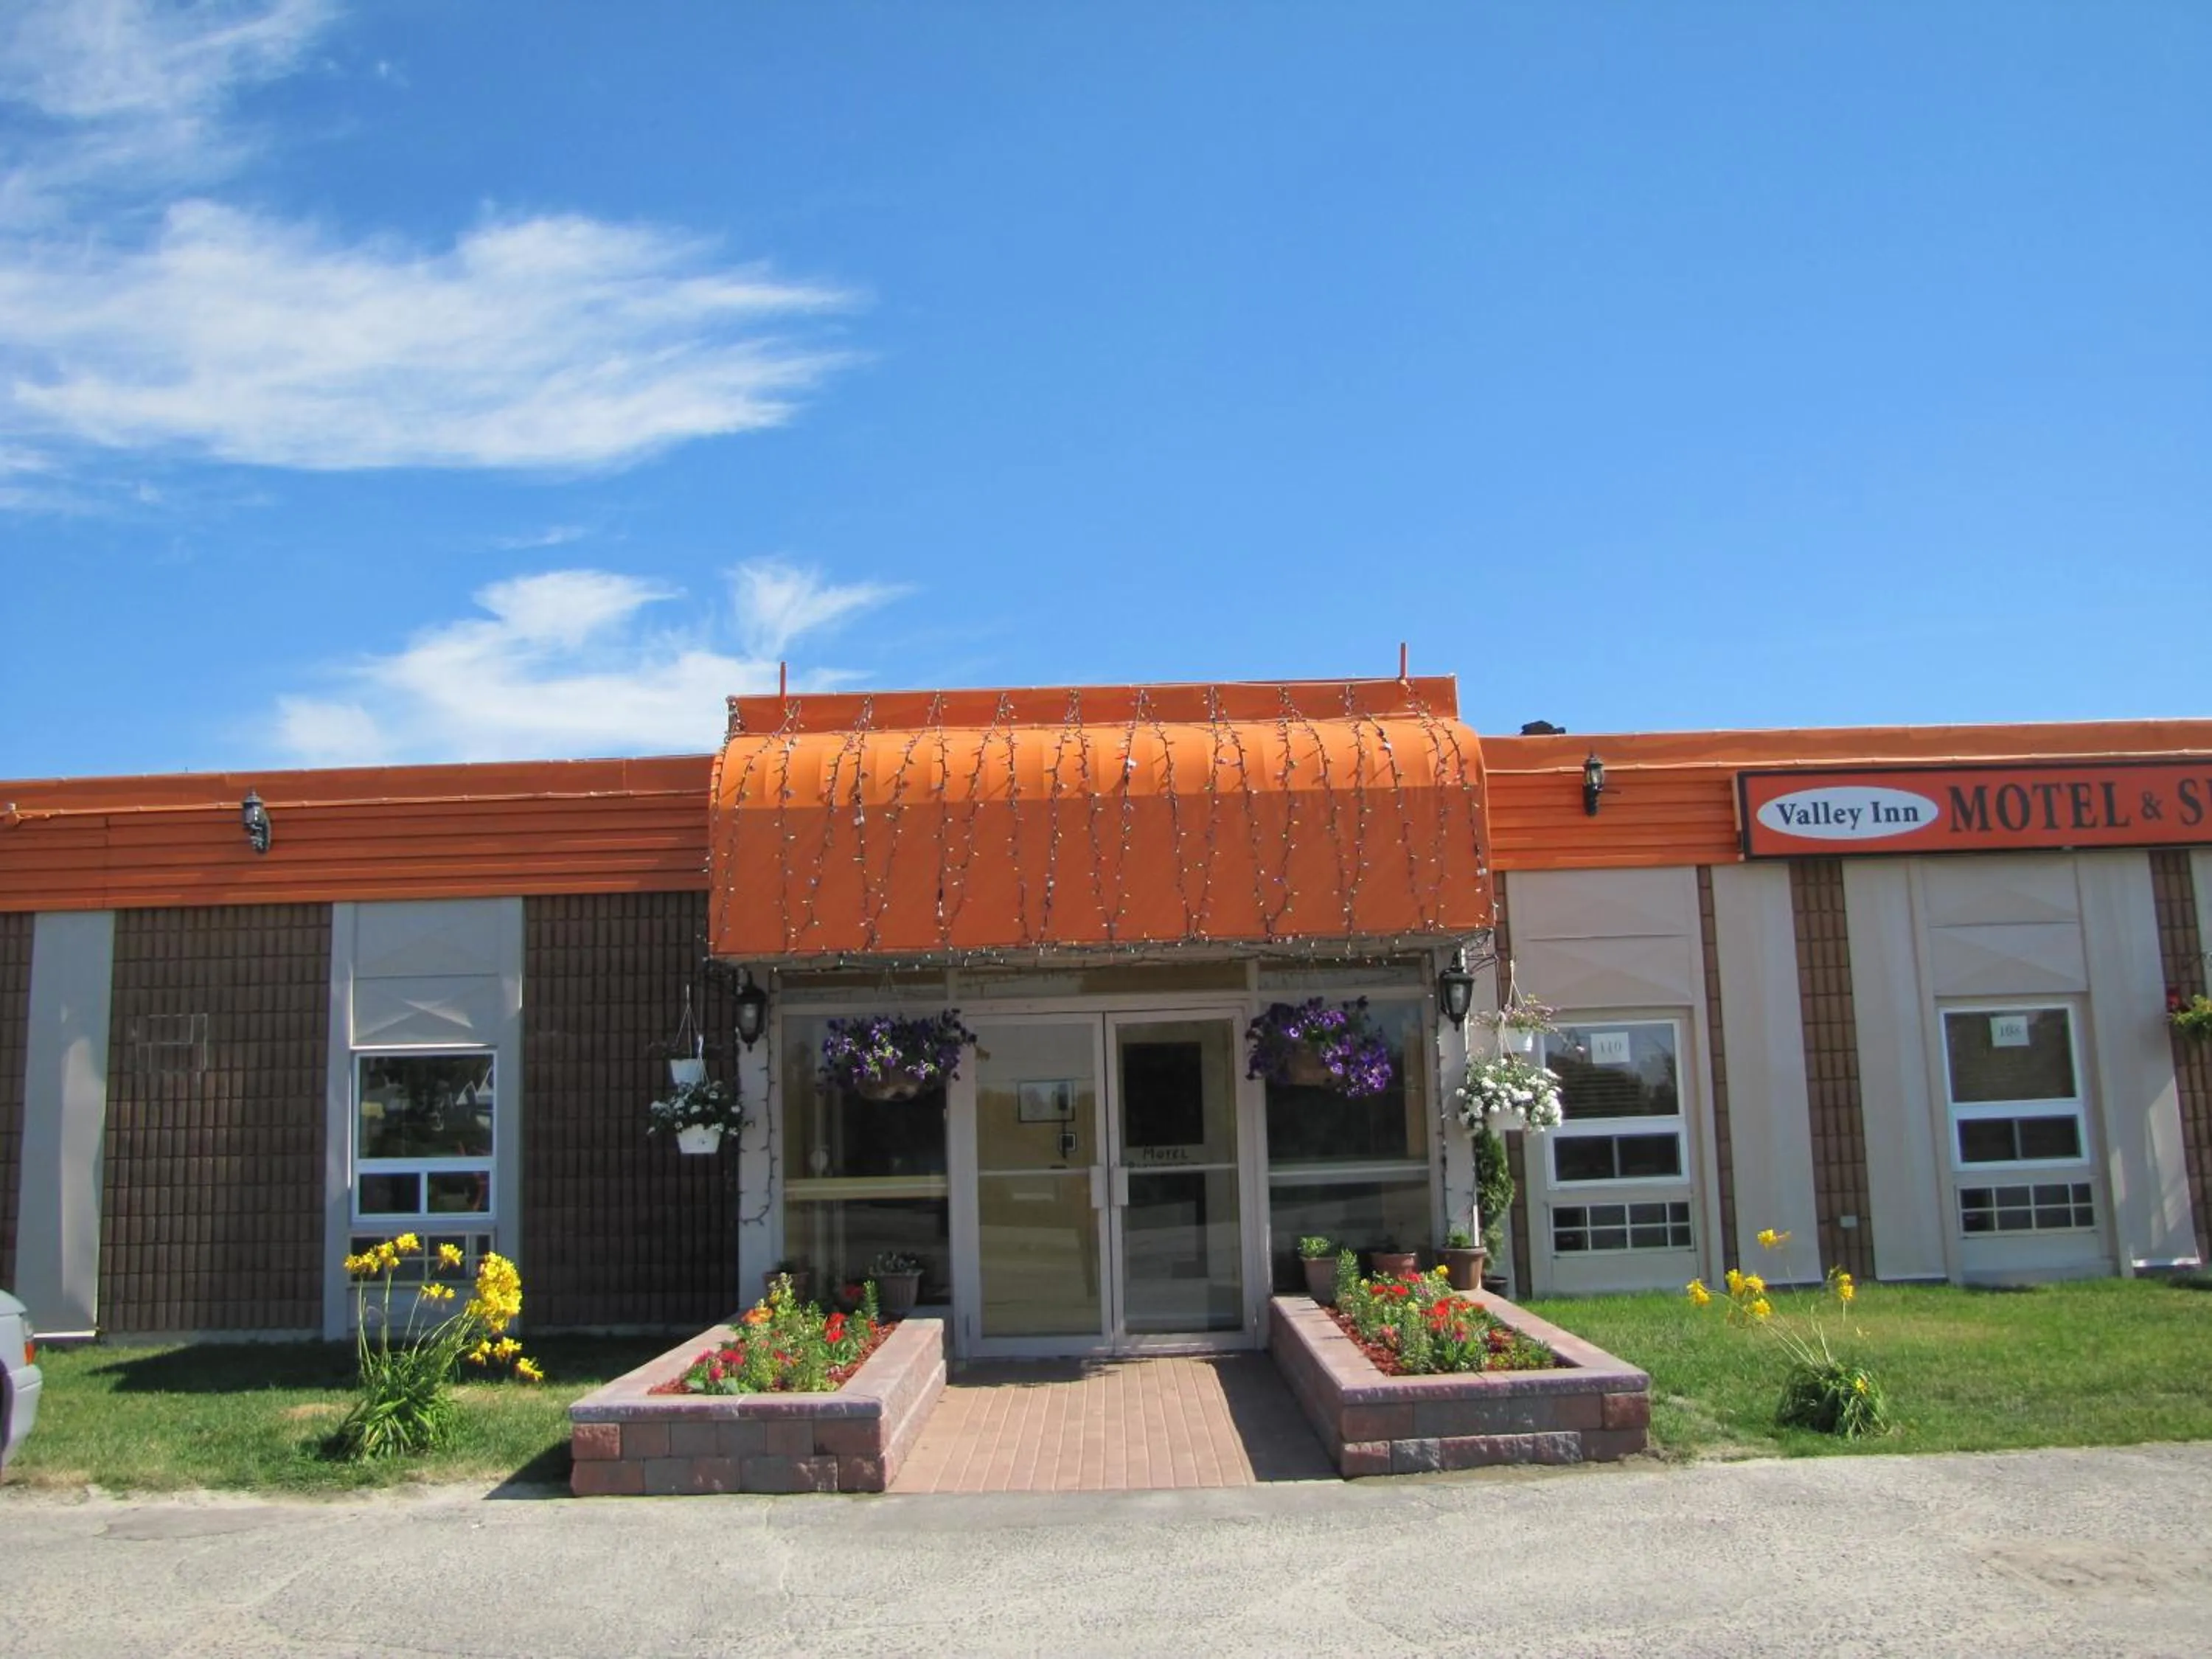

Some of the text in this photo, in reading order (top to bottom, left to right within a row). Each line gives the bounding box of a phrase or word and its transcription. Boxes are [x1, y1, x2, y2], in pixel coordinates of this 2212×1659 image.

[1775, 801, 1920, 830] Valley Inn
[1946, 777, 2212, 833] MOTEL & S
